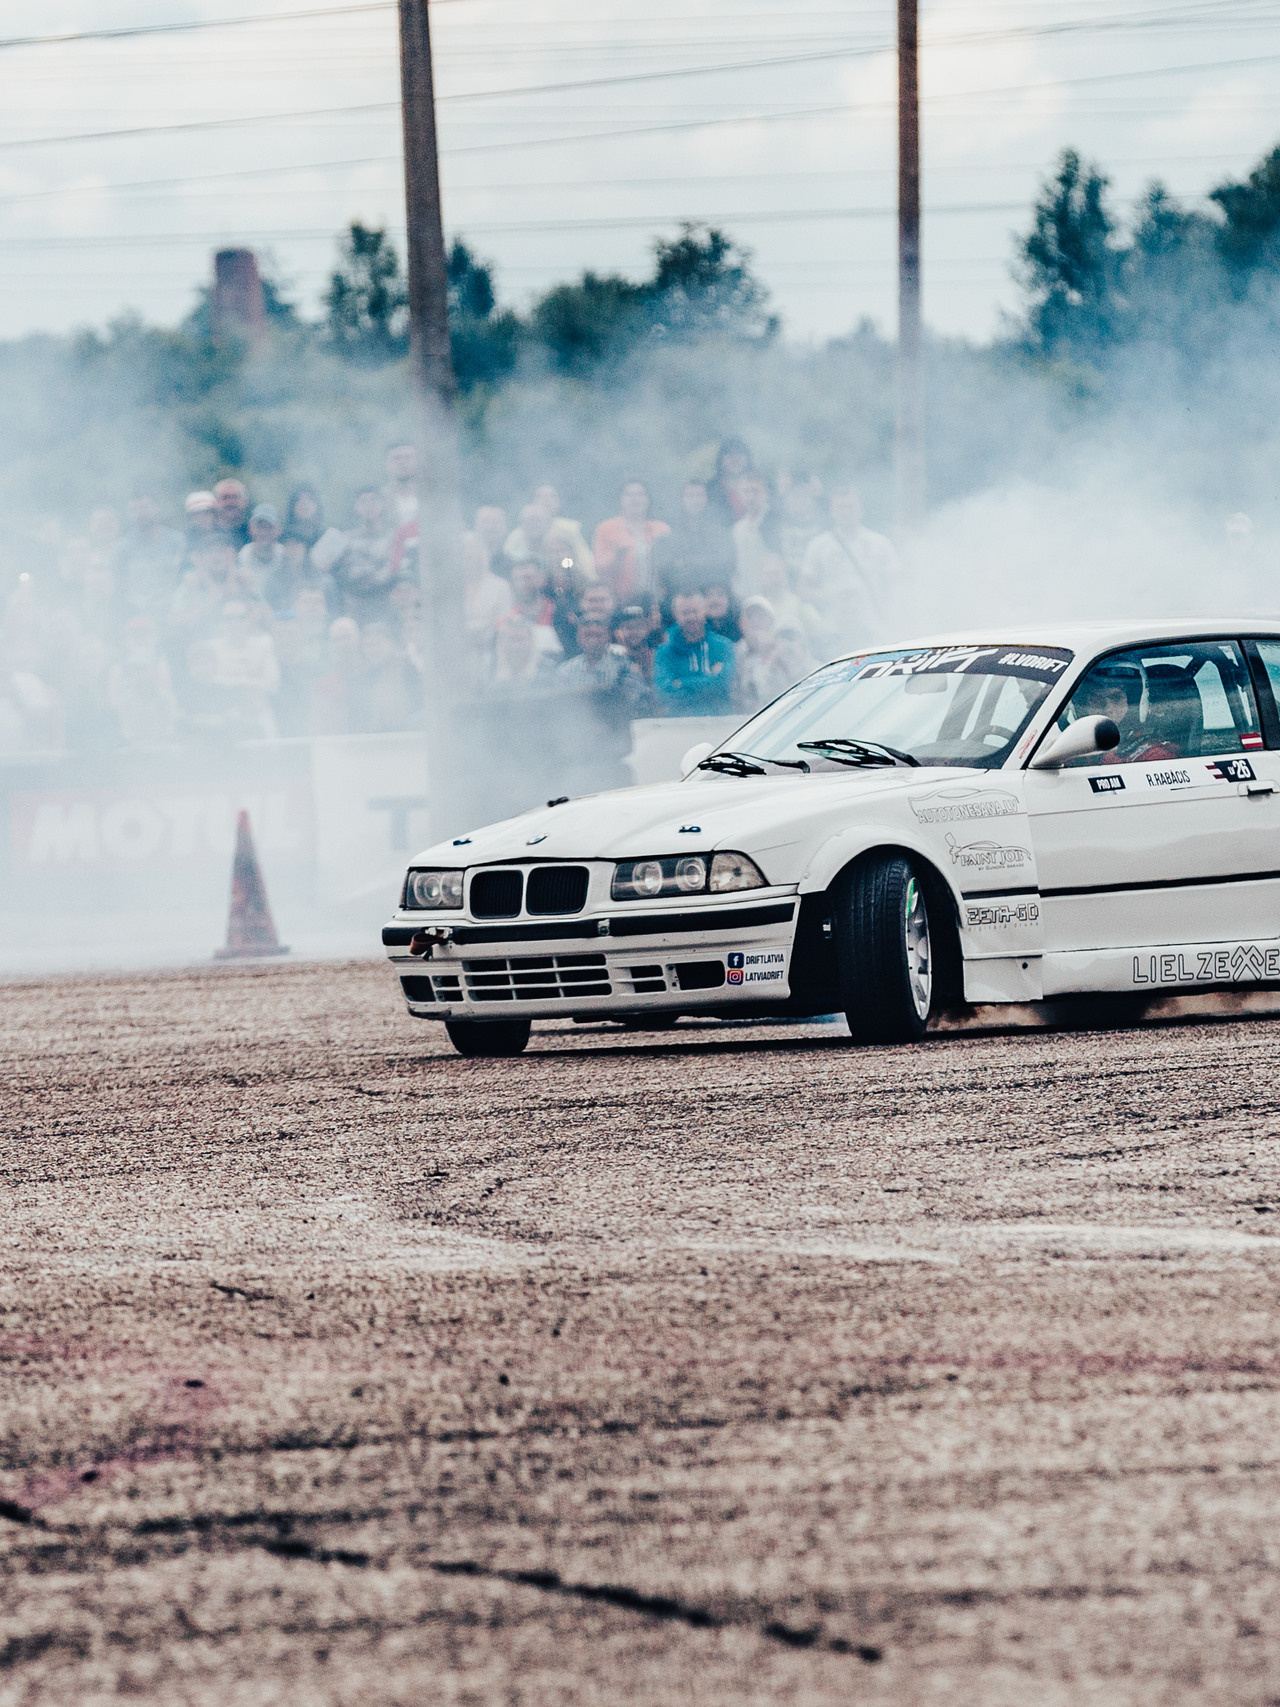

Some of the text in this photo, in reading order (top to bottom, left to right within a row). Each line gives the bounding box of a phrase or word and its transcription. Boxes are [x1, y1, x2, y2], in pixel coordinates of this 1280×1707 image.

[850, 646, 999, 683] DRIFT
[998, 652, 1069, 673] #LVDRIFT
[1232, 760, 1251, 779] 26
[1096, 777, 1121, 790] PRO AM
[917, 799, 1019, 824] AUTOTONESANA.LV
[960, 849, 1025, 867] PAINT JOB
[967, 903, 1039, 925] ZETA-GO
[745, 953, 785, 965] DRIFTLATVIA
[745, 970, 784, 982] LATVIADRIFT
